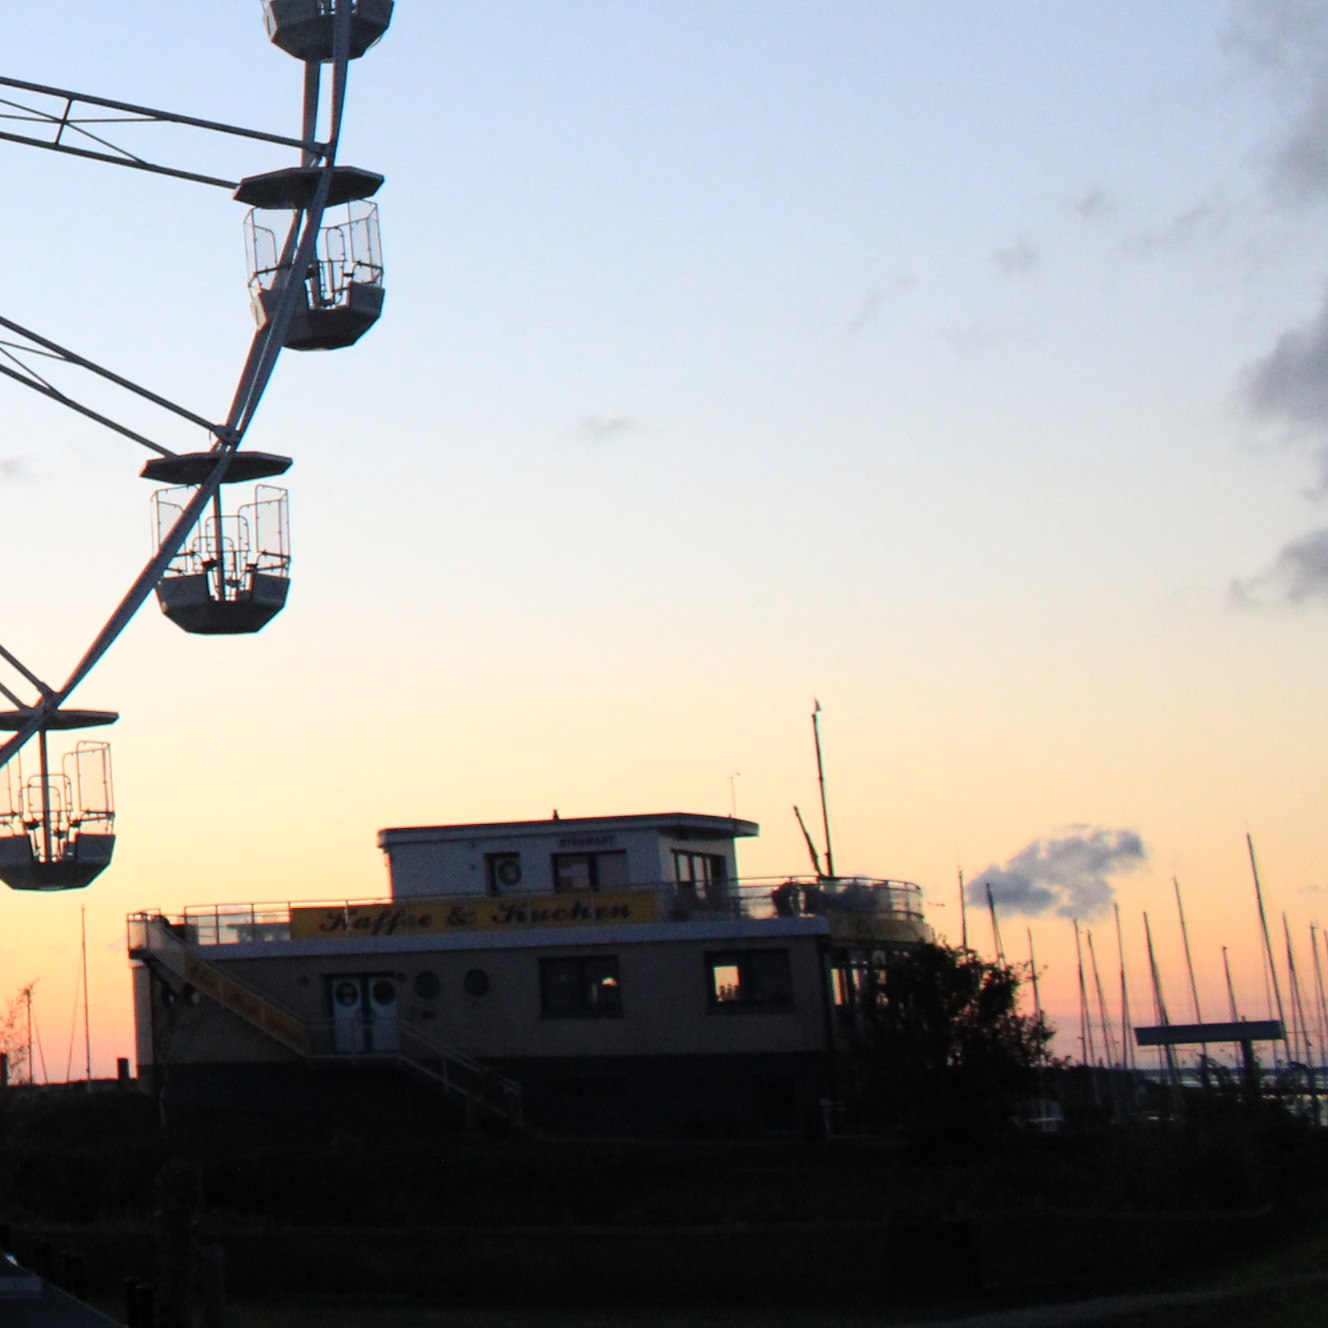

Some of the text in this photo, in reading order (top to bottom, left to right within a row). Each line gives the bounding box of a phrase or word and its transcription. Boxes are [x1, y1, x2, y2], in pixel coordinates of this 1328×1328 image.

[319, 899, 631, 935] Kaffee & Kuchen
